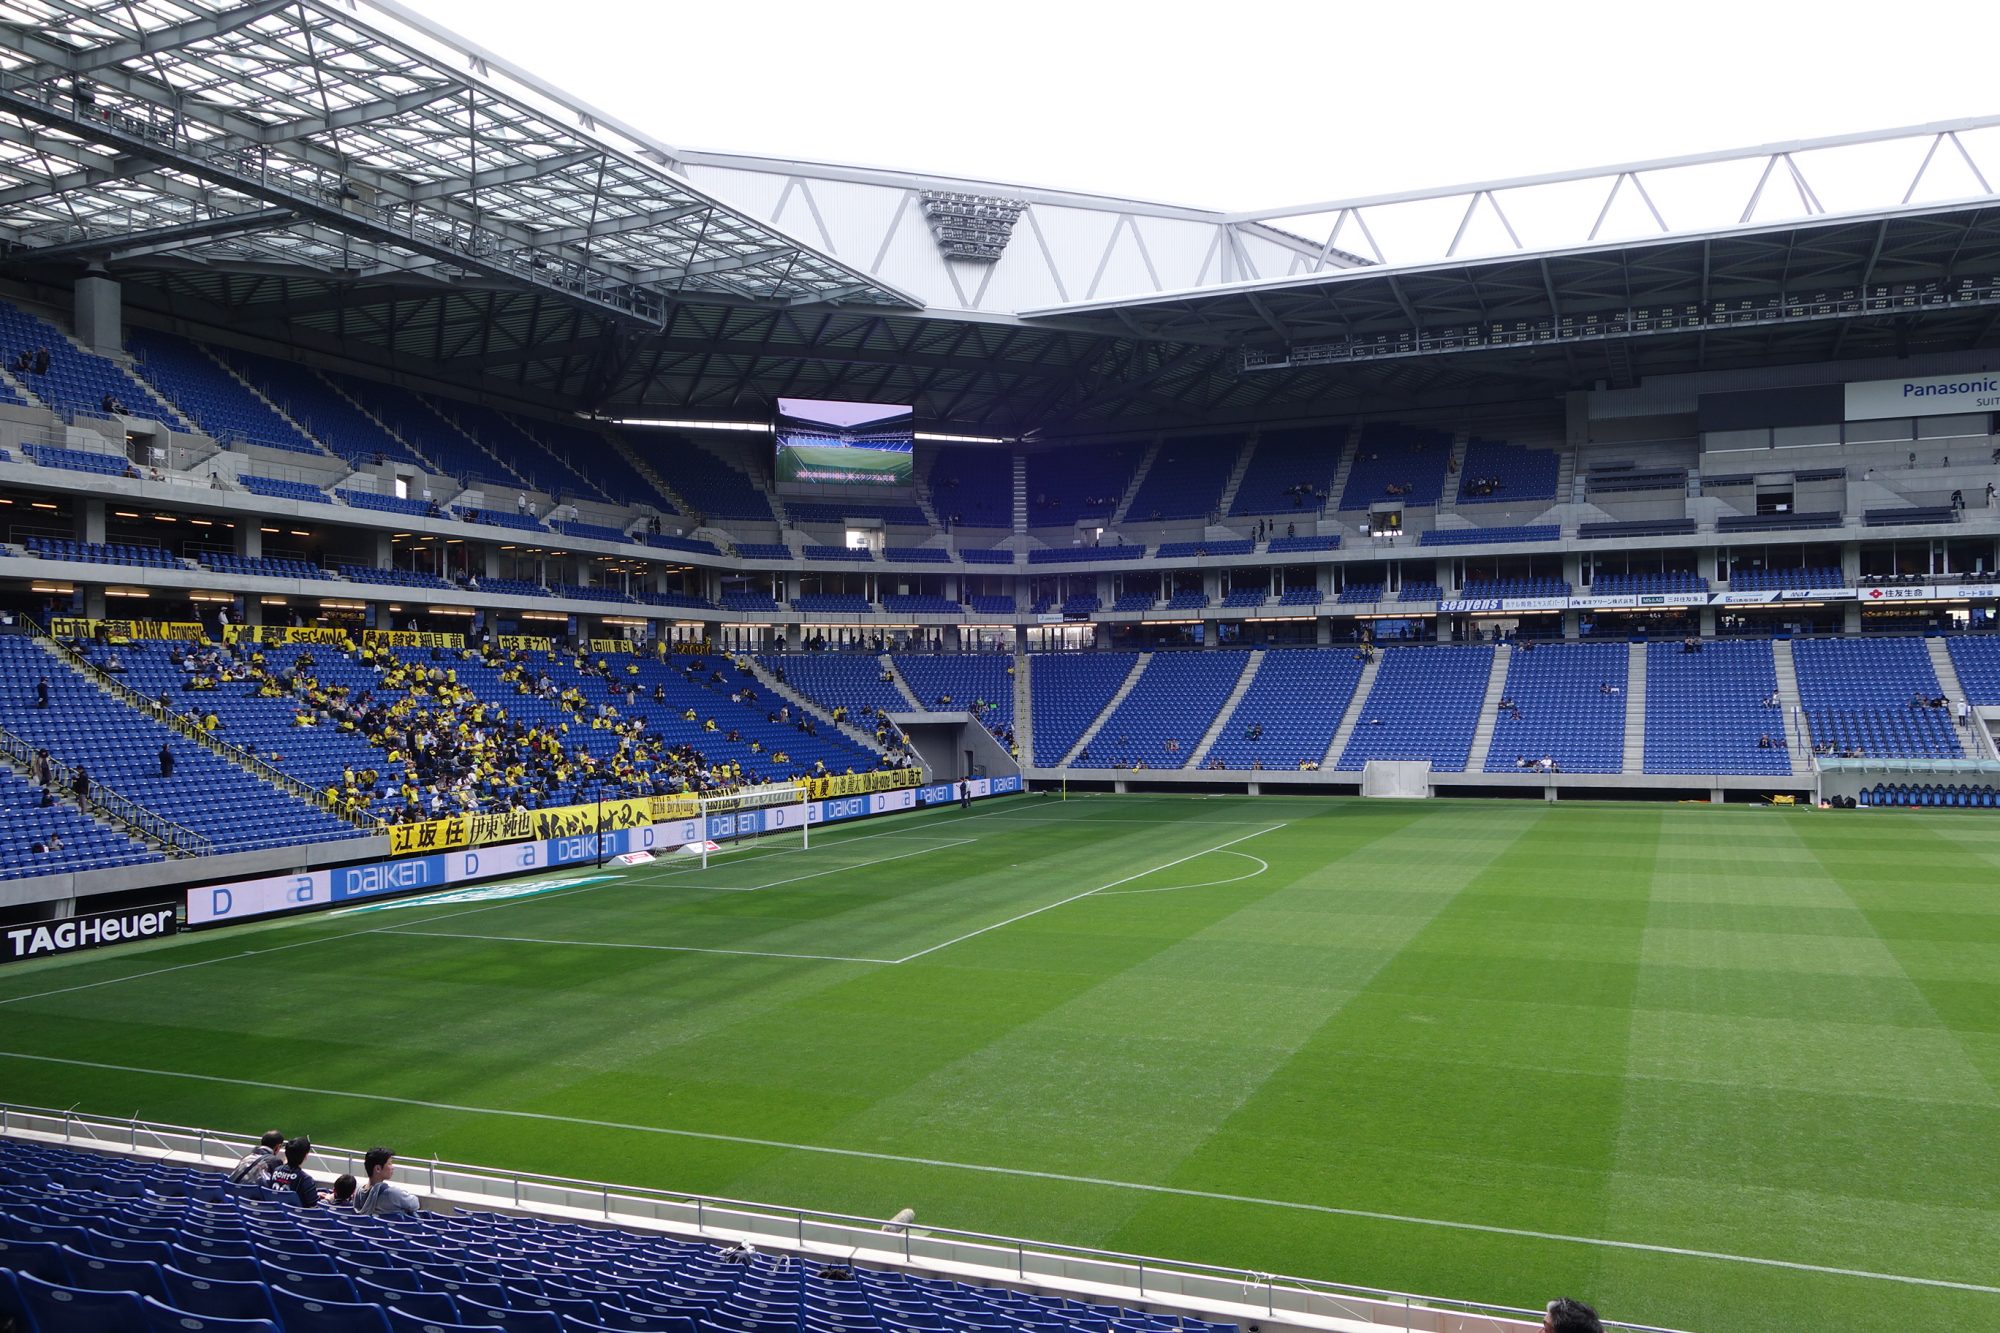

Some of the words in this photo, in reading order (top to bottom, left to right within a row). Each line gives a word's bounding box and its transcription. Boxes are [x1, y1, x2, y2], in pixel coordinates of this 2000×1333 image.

[1903, 377, 1998, 398] Panasonic
[1885, 589, 1923, 598] 住友生命
[1440, 599, 1498, 612] seayens
[135, 621, 162, 640] PARK
[291, 628, 343, 645] SEGAWA
[469, 813, 531, 844] 伊東純也
[643, 828, 654, 848] D
[465, 853, 479, 876] D
[212, 888, 233, 916] D
[272, 1170, 298, 1180] ROHTO
